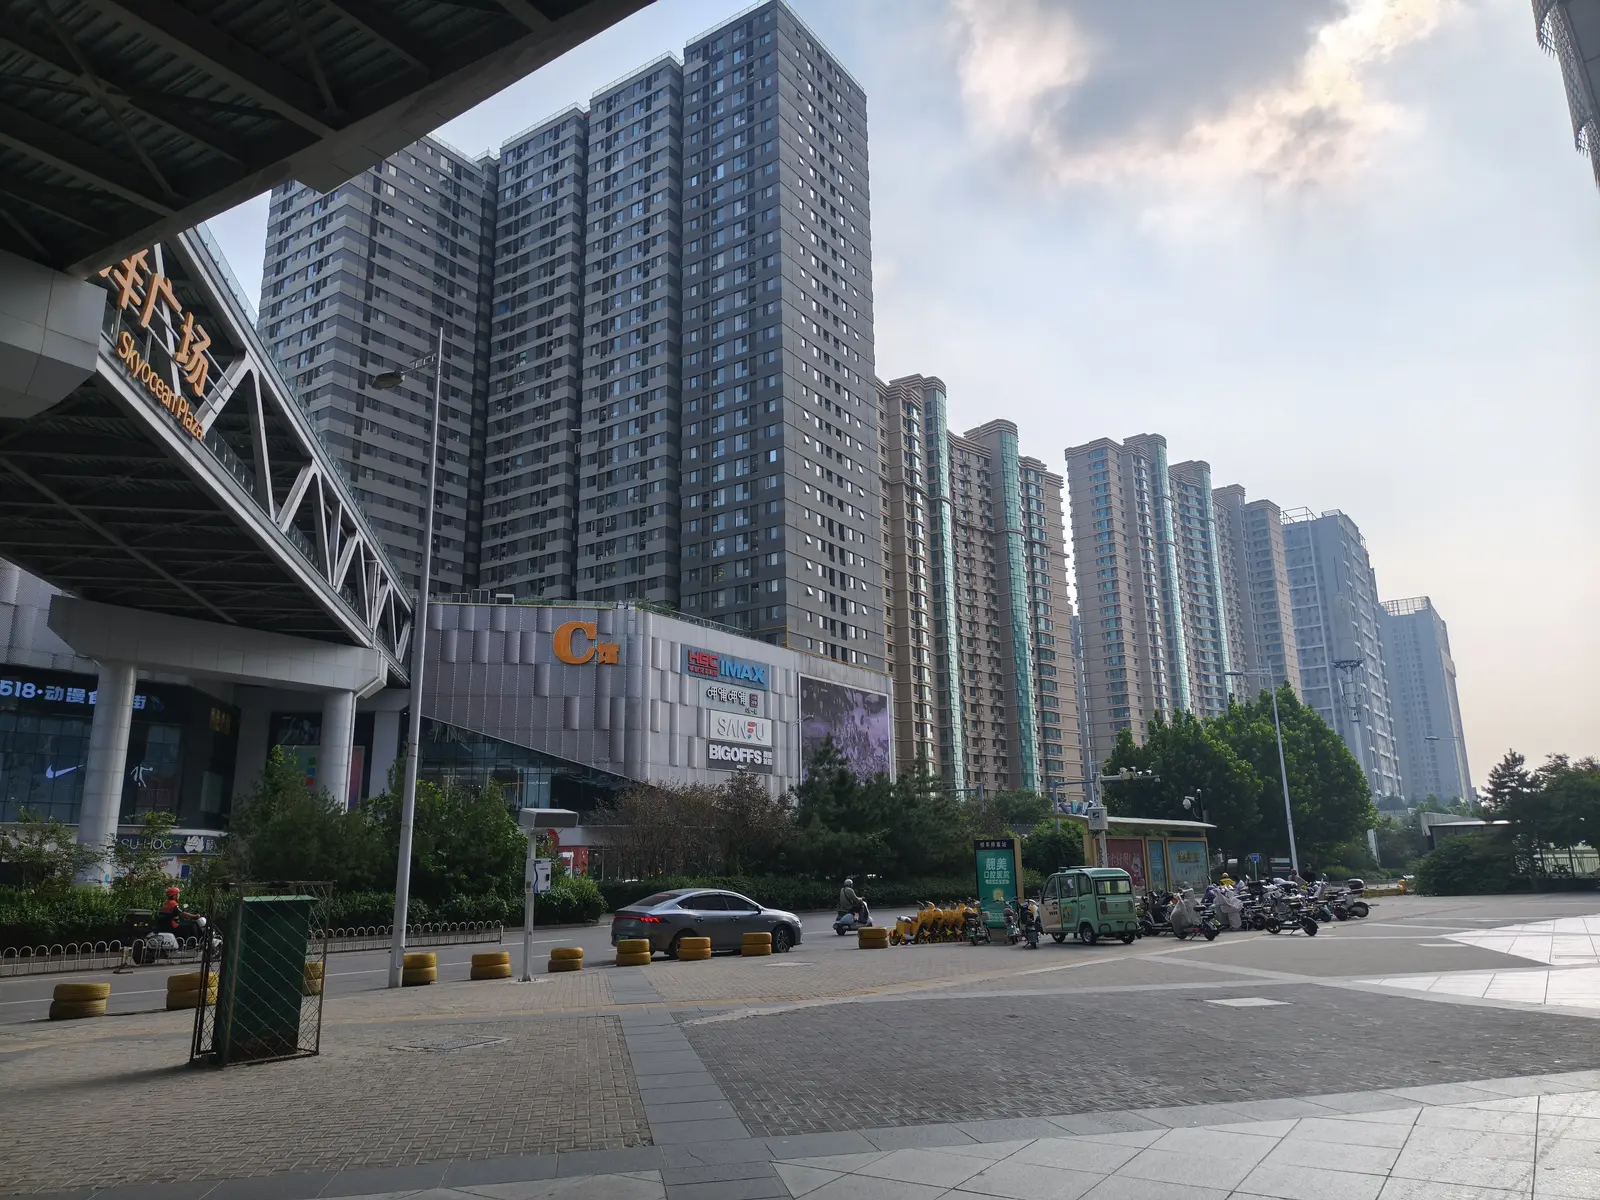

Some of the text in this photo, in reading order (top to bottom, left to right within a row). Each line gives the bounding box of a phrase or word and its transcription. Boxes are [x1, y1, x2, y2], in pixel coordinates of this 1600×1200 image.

[116, 331, 205, 441] Skyocean Plaza
[720, 659, 765, 684] IMAX
[717, 717, 765, 741] SANFU
[708, 744, 762, 765] BIGOFFS
[983, 870, 1010, 879] 口腔医院
[986, 857, 1007, 871] 靓美
